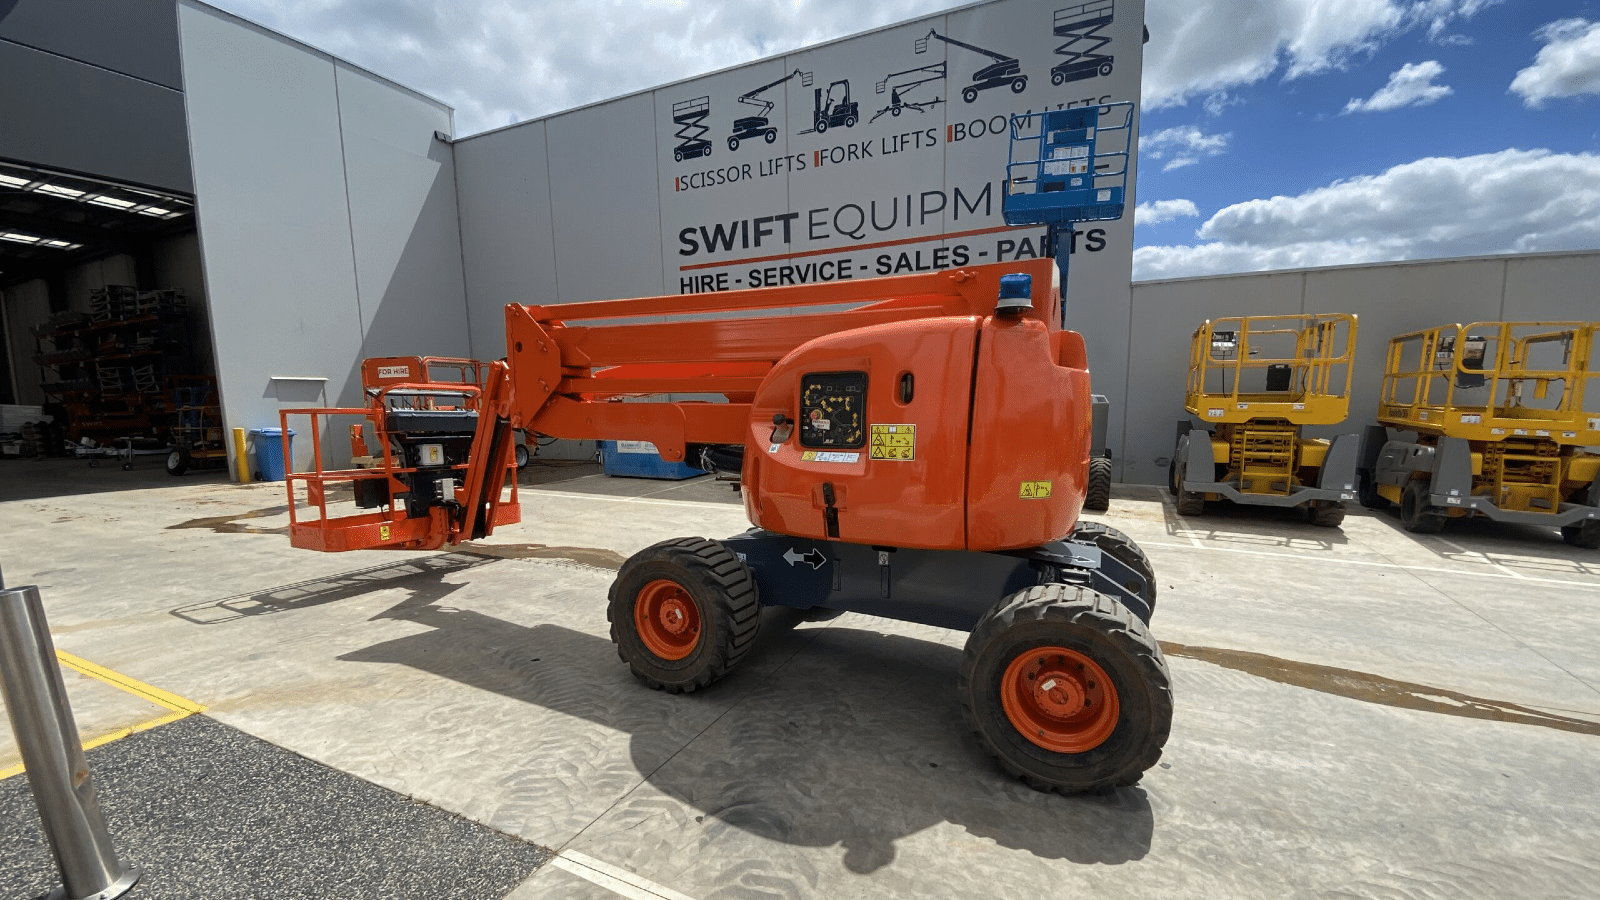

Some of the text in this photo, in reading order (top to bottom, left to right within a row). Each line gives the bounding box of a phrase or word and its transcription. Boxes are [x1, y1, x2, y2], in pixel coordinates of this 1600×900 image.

[680, 109, 1031, 191] SCISSOR LIFTS FORK LIFTS BOOM
[679, 212, 799, 256] SWIFT
[680, 272, 729, 294] HIRE
[748, 259, 852, 289] SERVICE
[876, 244, 970, 275] SALES
[393, 367, 409, 375] HIRE
